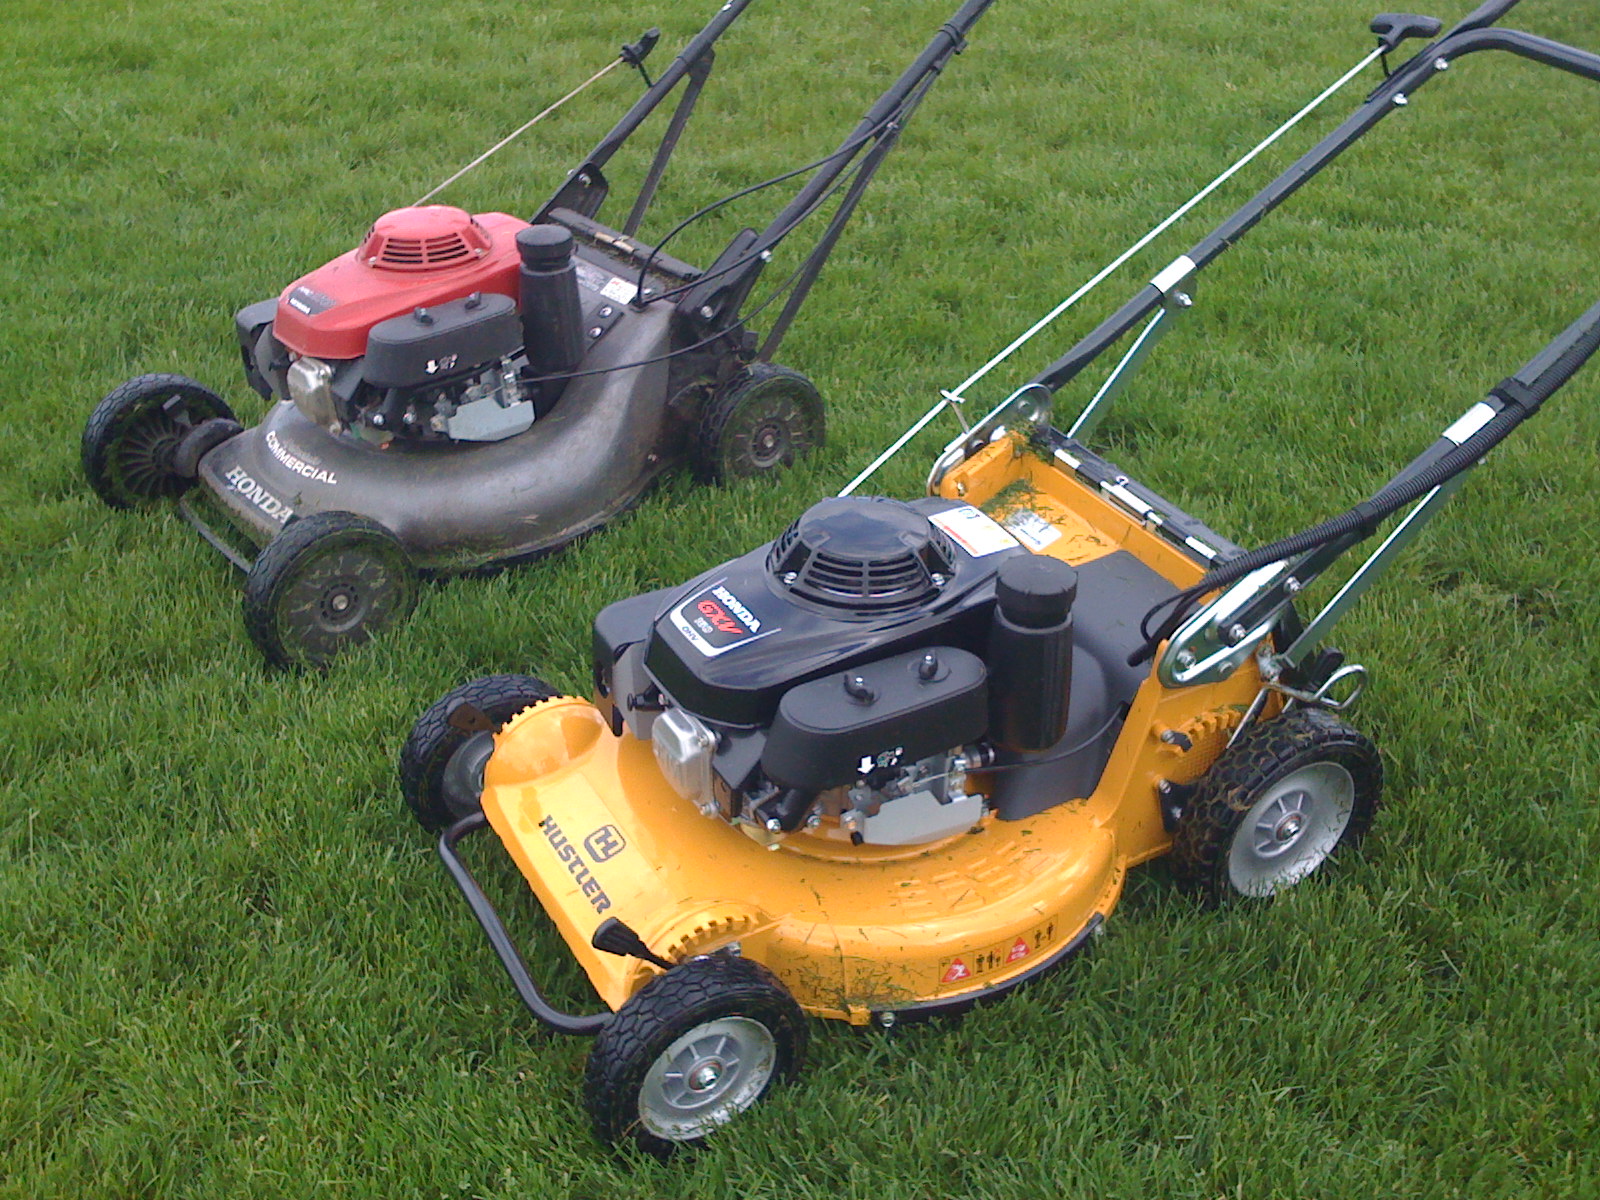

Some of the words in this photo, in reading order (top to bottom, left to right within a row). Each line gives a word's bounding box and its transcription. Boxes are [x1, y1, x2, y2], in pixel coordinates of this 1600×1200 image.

[265, 430, 338, 485] COMMERCIAL
[224, 464, 294, 524] HONDA
[711, 585, 761, 633] HONDA
[538, 814, 611, 915] HUSTLER
